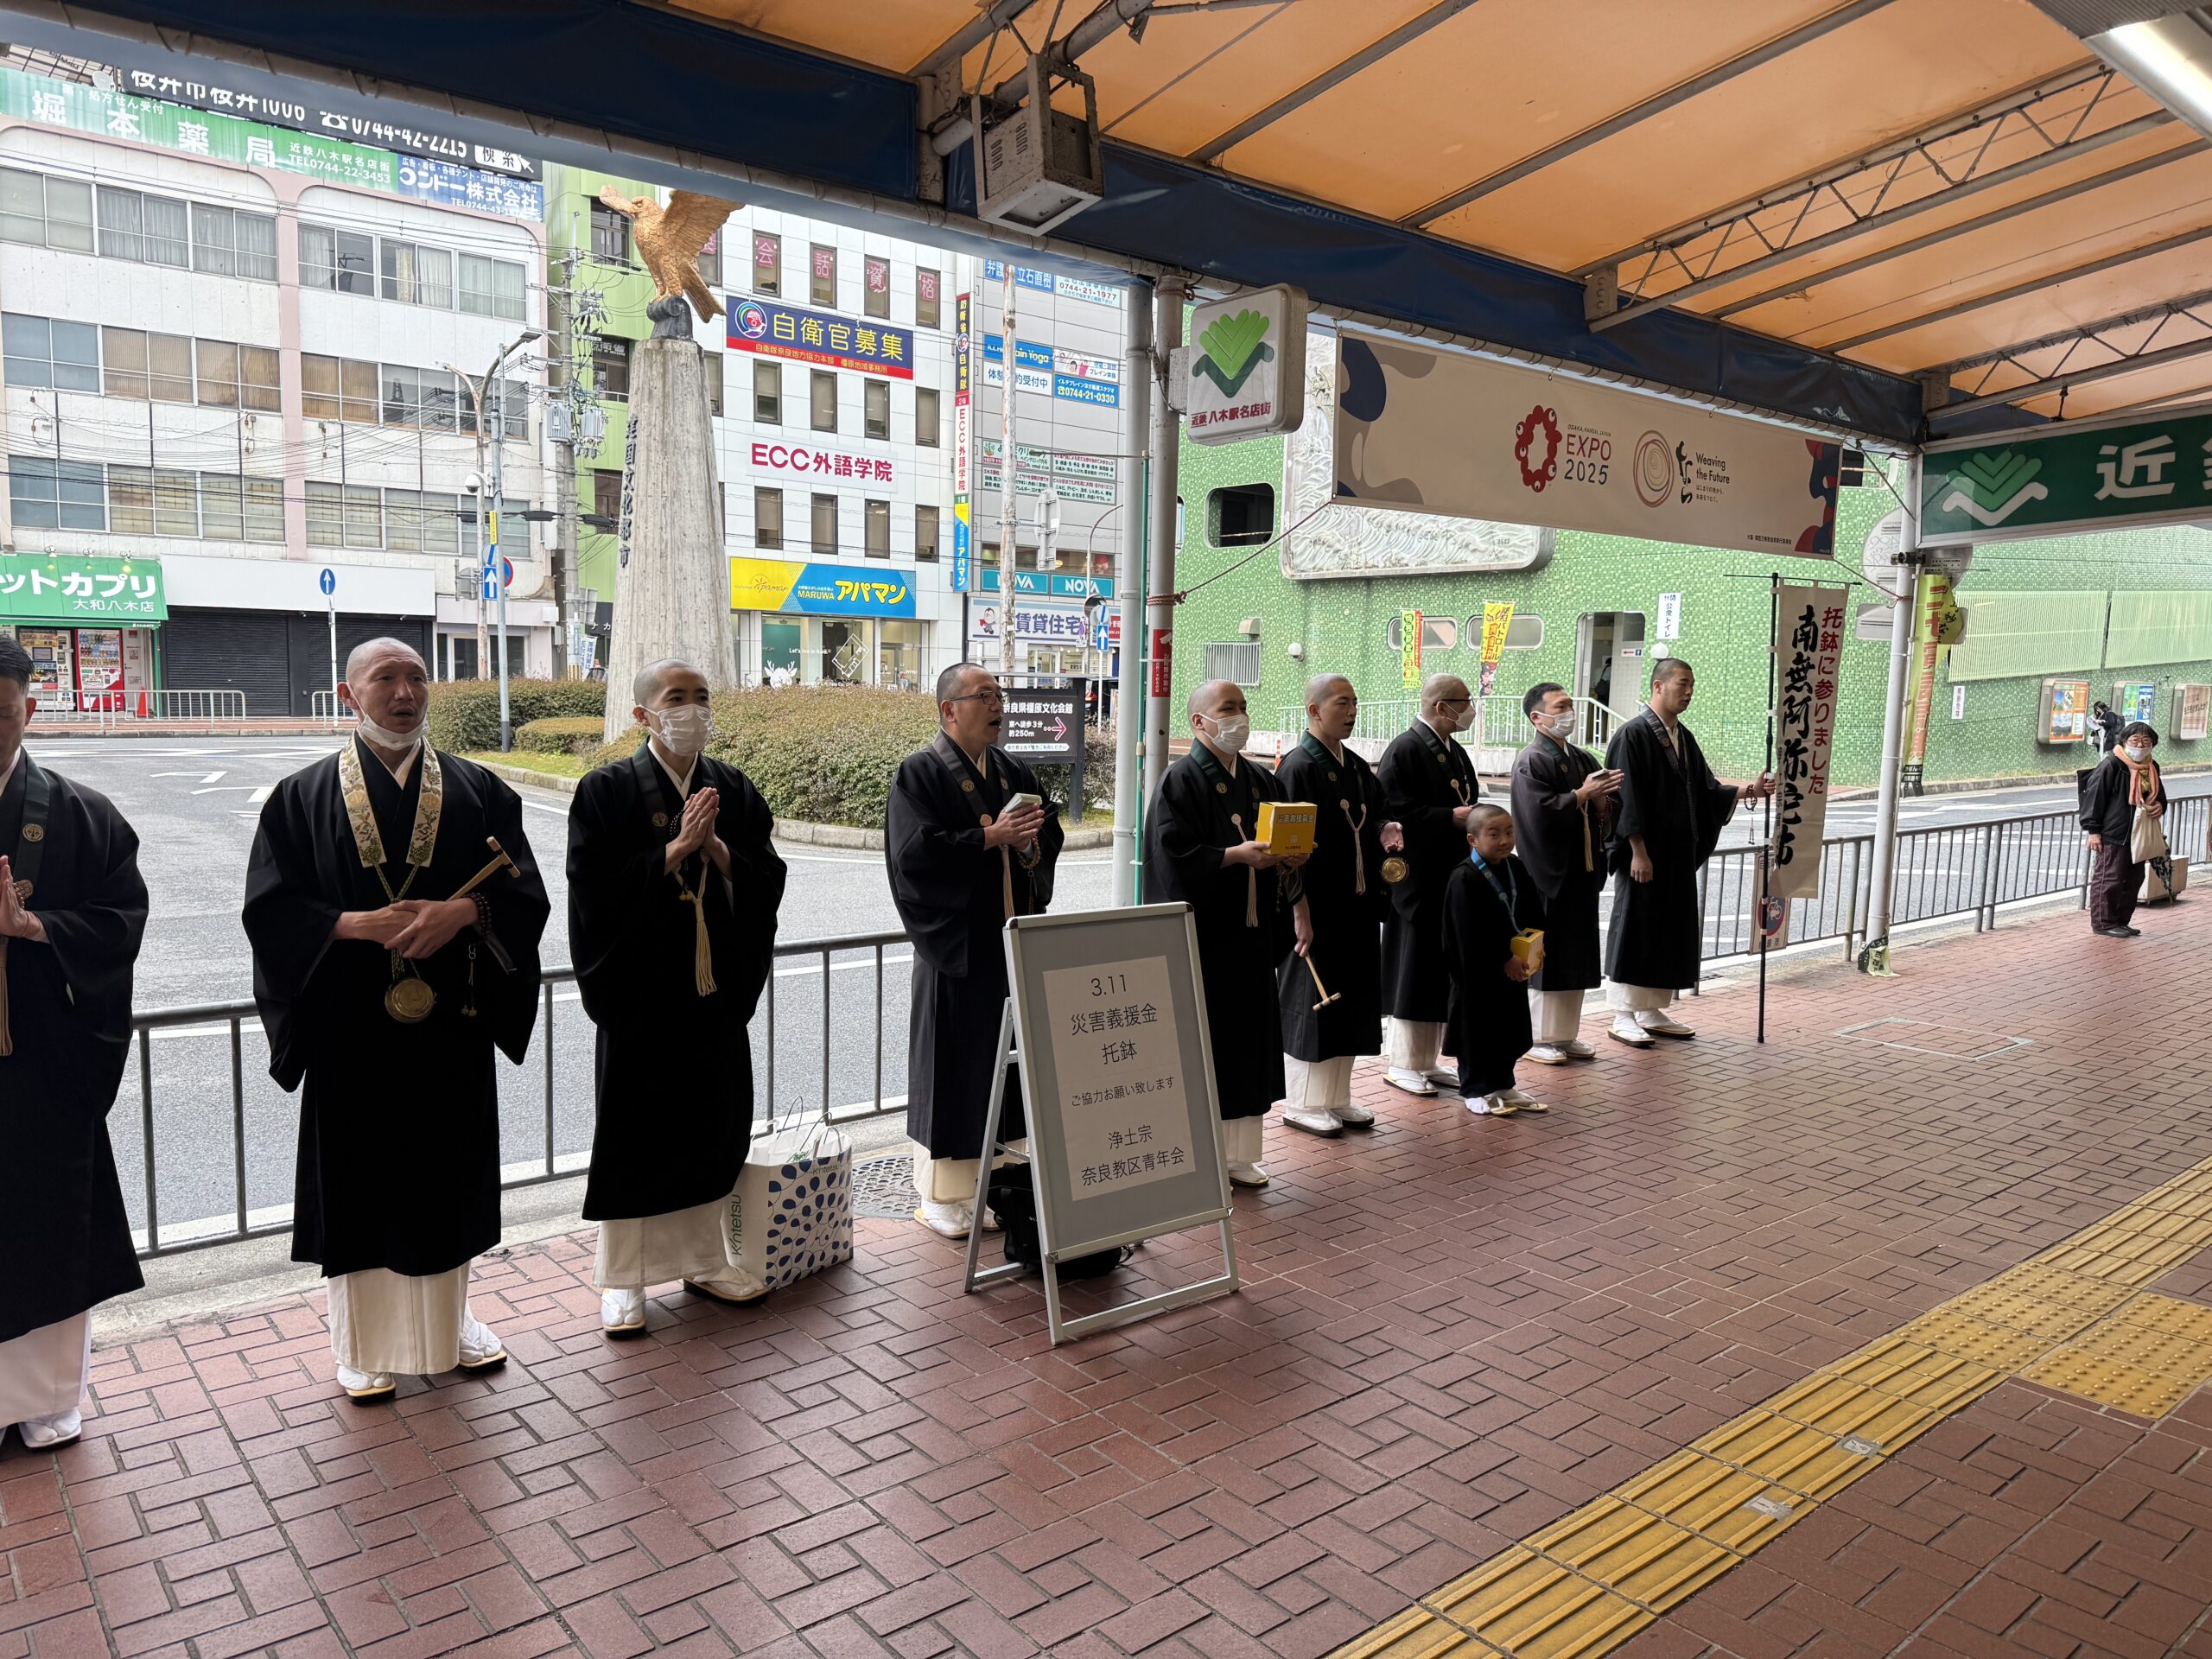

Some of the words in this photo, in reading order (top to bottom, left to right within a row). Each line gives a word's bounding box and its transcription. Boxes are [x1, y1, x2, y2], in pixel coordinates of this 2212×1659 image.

[32, 89, 276, 169] 堀本薬局
[288, 154, 391, 185] TEL0744-22-3453
[289, 141, 390, 173] 近鉄八木駅名店街
[398, 167, 540, 214] コンドー株式会社
[759, 240, 774, 265] 会
[816, 252, 830, 277] 話
[869, 262, 885, 288] 資
[921, 274, 934, 299] 格
[1059, 282, 1117, 302] 0744-21-1977
[772, 312, 904, 362] 自衛官募集
[755, 342, 835, 365] 自衛隊奈良地方協力本部
[1029, 350, 1049, 364] Yoga
[988, 368, 1048, 389] 体験約受付中
[1065, 387, 1115, 404] 0744-21-0330
[1208, 403, 1272, 424] 八木駅名店街
[957, 408, 967, 491] ECC外語学院
[1566, 434, 1611, 461] EXPO
[751, 442, 893, 482] ECC外語学院
[1564, 459, 1609, 486] 2025
[1695, 452, 1726, 472] Weaving
[1696, 468, 1707, 482] the
[1708, 470, 1731, 485] Future
[957, 546, 966, 587] アパマン
[0, 569, 156, 599] ットカプリ
[798, 590, 835, 601] MARUWA
[835, 580, 906, 605] アパマン
[1065, 578, 1100, 594] NOVA
[73, 599, 155, 613] 大和八木店
[1015, 612, 1081, 636] 賃貸住宅
[1664, 602, 1673, 638] 公衆トイレ
[1003, 702, 1073, 715] 奈良県橿原文化会館
[1808, 606, 1843, 795] 托鉢に参りました
[1008, 720, 1043, 729] 東へ徒歩3分
[1090, 974, 1128, 996] 3.11
[1071, 1002, 1158, 1036] 災害義援金
[1102, 1039, 1138, 1065] 托鉢
[1071, 1076, 1175, 1107] ご協力お願い致します
[1108, 1124, 1153, 1150] 浄土宗
[1081, 1146, 1185, 1186] 奈良教区青年会
